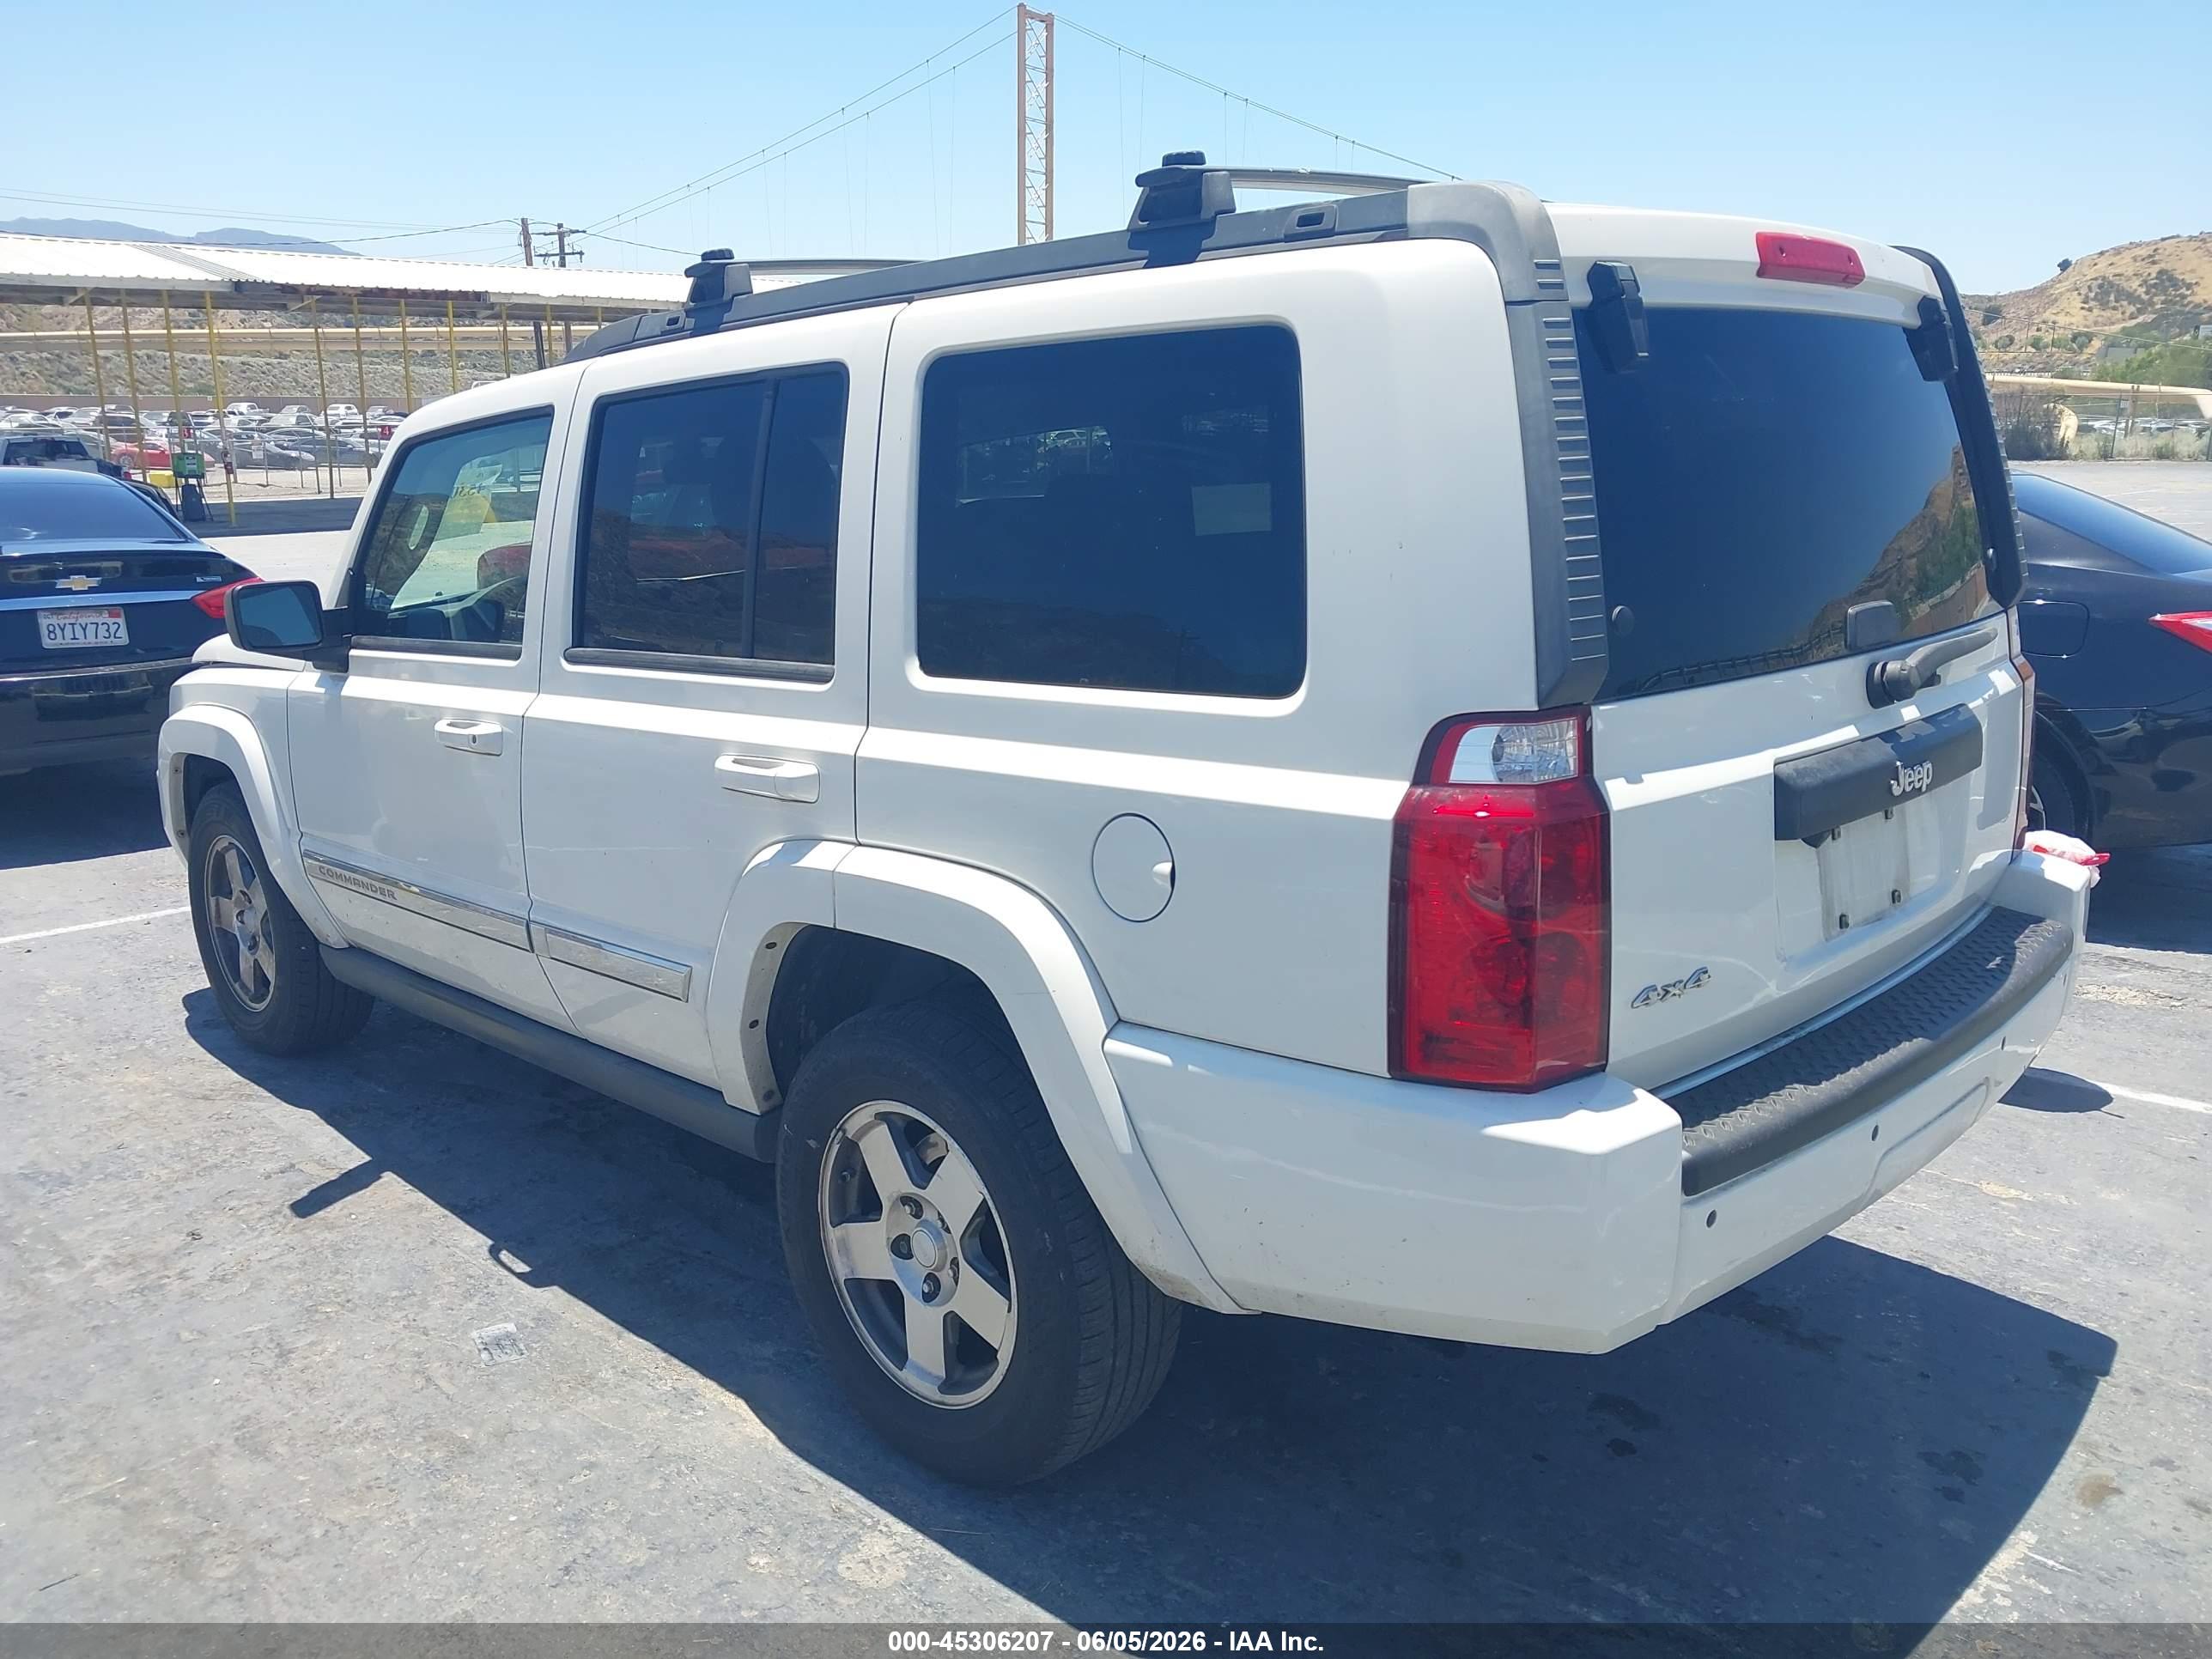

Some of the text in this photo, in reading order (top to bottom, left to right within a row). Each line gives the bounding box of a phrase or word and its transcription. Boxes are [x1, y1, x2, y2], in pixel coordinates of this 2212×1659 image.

[383, 426, 390, 435] 4
[55, 611, 100, 623] California
[47, 622, 123, 641] 8YIY732
[1891, 761, 1933, 796] Jeep
[318, 866, 397, 900] COMMANDER
[1631, 966, 1711, 1009] 4x4
